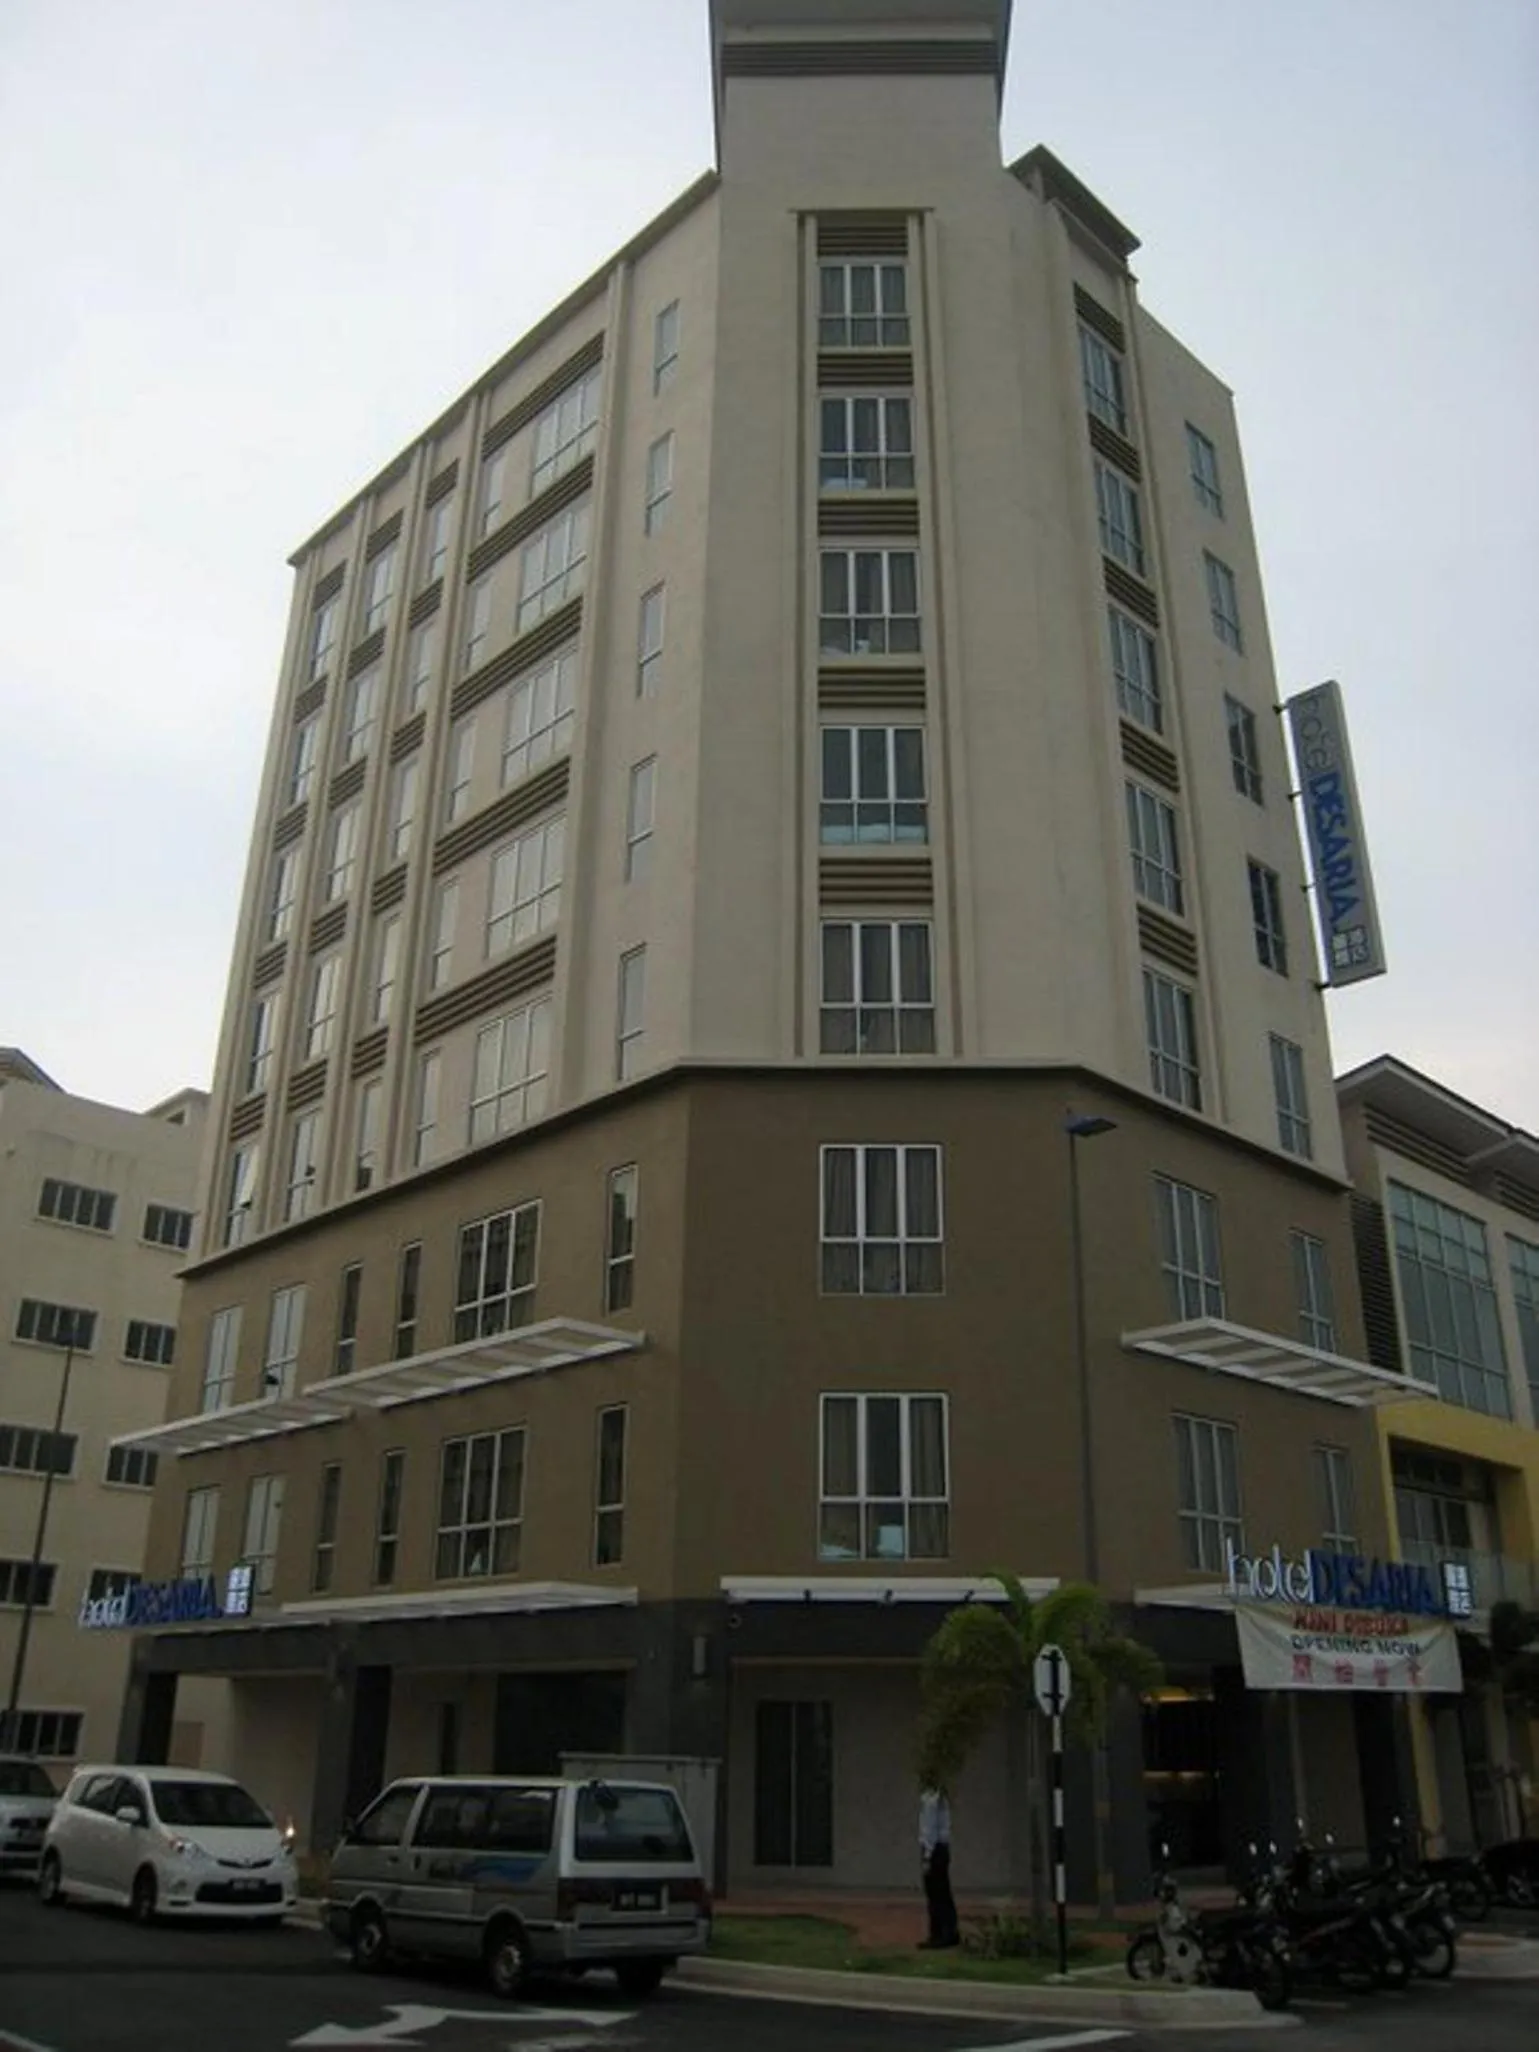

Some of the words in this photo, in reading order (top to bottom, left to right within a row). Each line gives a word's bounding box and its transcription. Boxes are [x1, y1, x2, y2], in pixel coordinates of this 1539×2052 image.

[1299, 691, 1335, 775] hotel
[1309, 771, 1361, 931] DESARIA
[1227, 1537, 1314, 1604] hotel
[1312, 1549, 1444, 1615] DESARIA
[1291, 1635, 1373, 1653] OPENING
